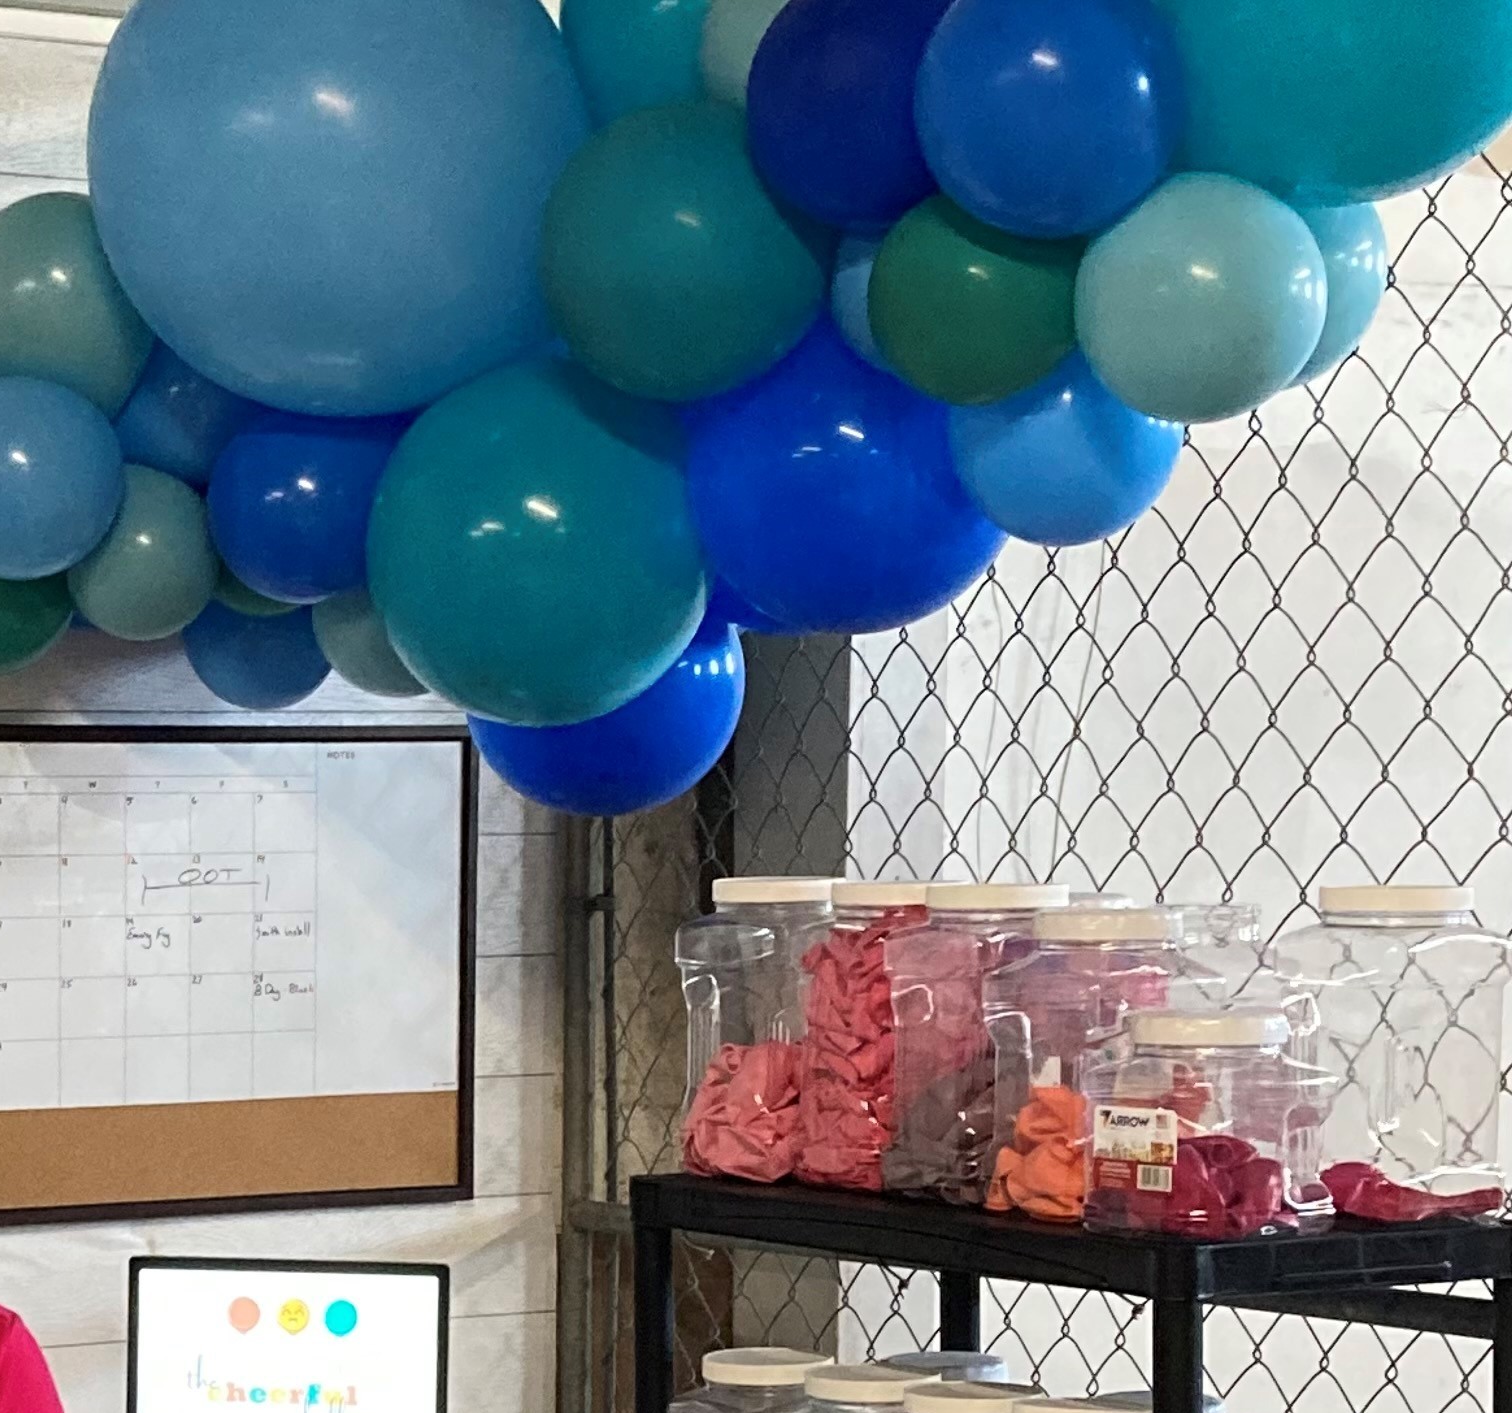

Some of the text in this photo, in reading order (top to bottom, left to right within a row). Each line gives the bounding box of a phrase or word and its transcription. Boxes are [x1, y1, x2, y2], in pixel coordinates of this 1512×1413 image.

[326, 751, 356, 761] NOTES
[1110, 1115, 1150, 1127] ARROW
[187, 1354, 220, 1389] the
[207, 1380, 358, 1406] cheerful
